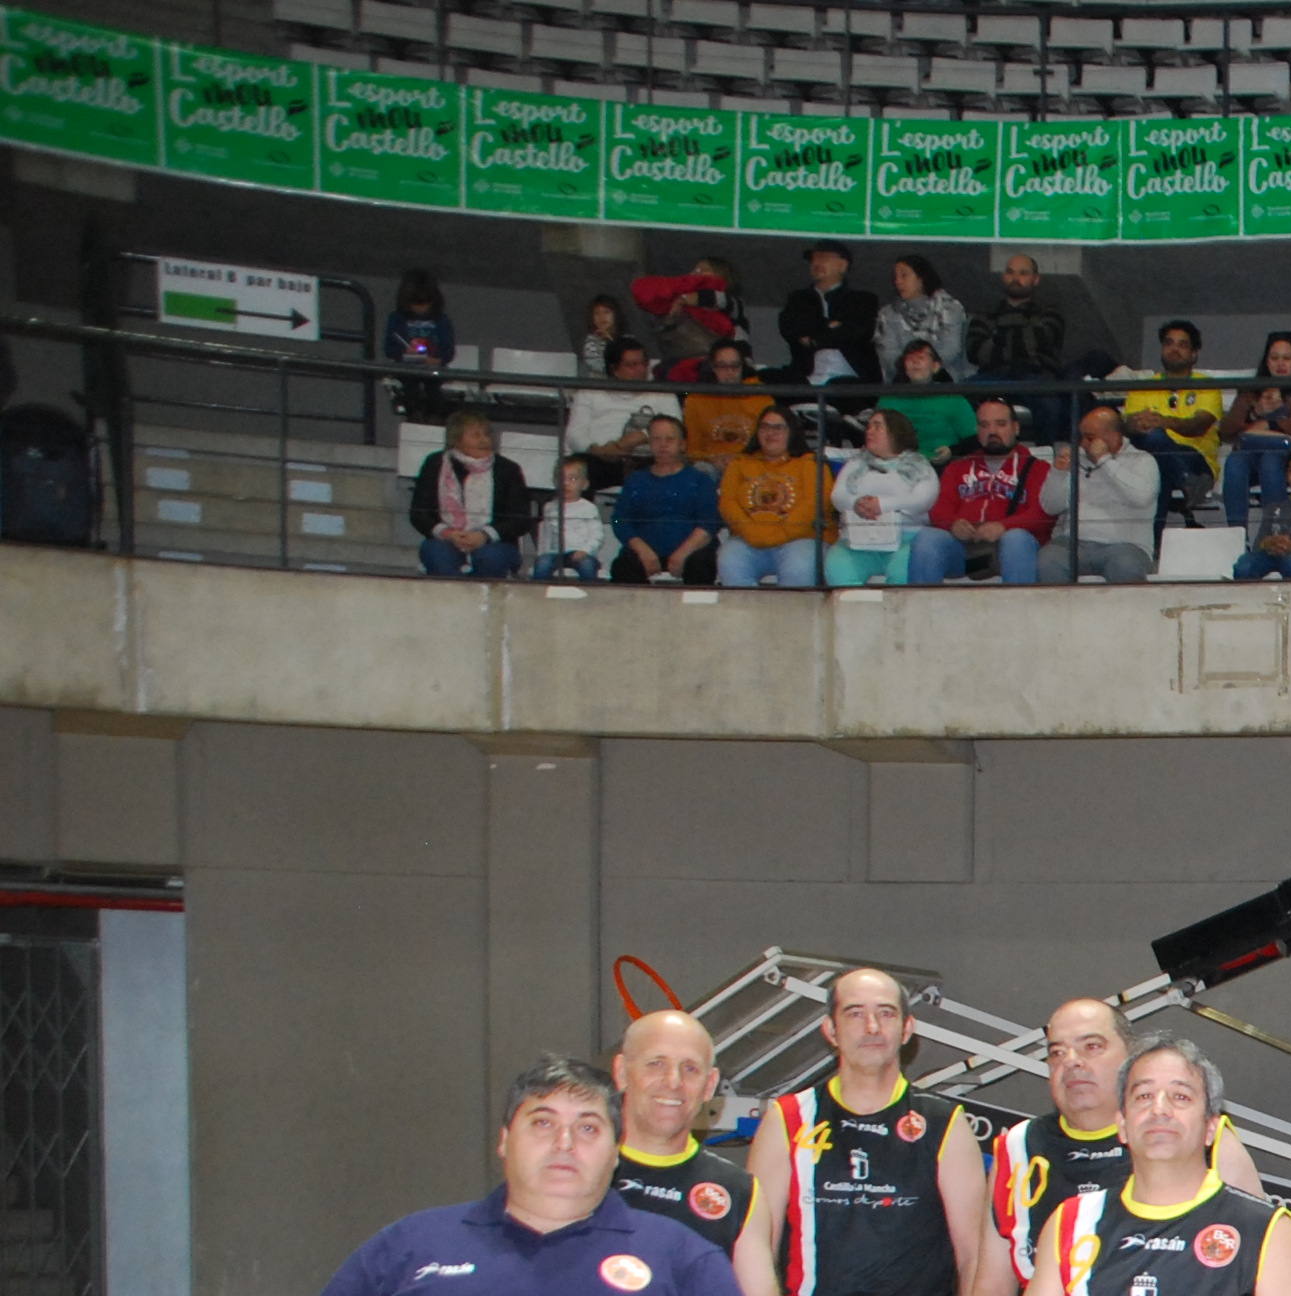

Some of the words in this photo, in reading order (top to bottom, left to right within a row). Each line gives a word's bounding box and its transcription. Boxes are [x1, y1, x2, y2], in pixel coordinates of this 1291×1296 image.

[792, 1120, 833, 1164] 14
[1005, 1155, 1050, 1216] 10
[1143, 1235, 1187, 1252] rasán
[1212, 1229, 1237, 1250] BSR
[1065, 1234, 1101, 1294] 9
